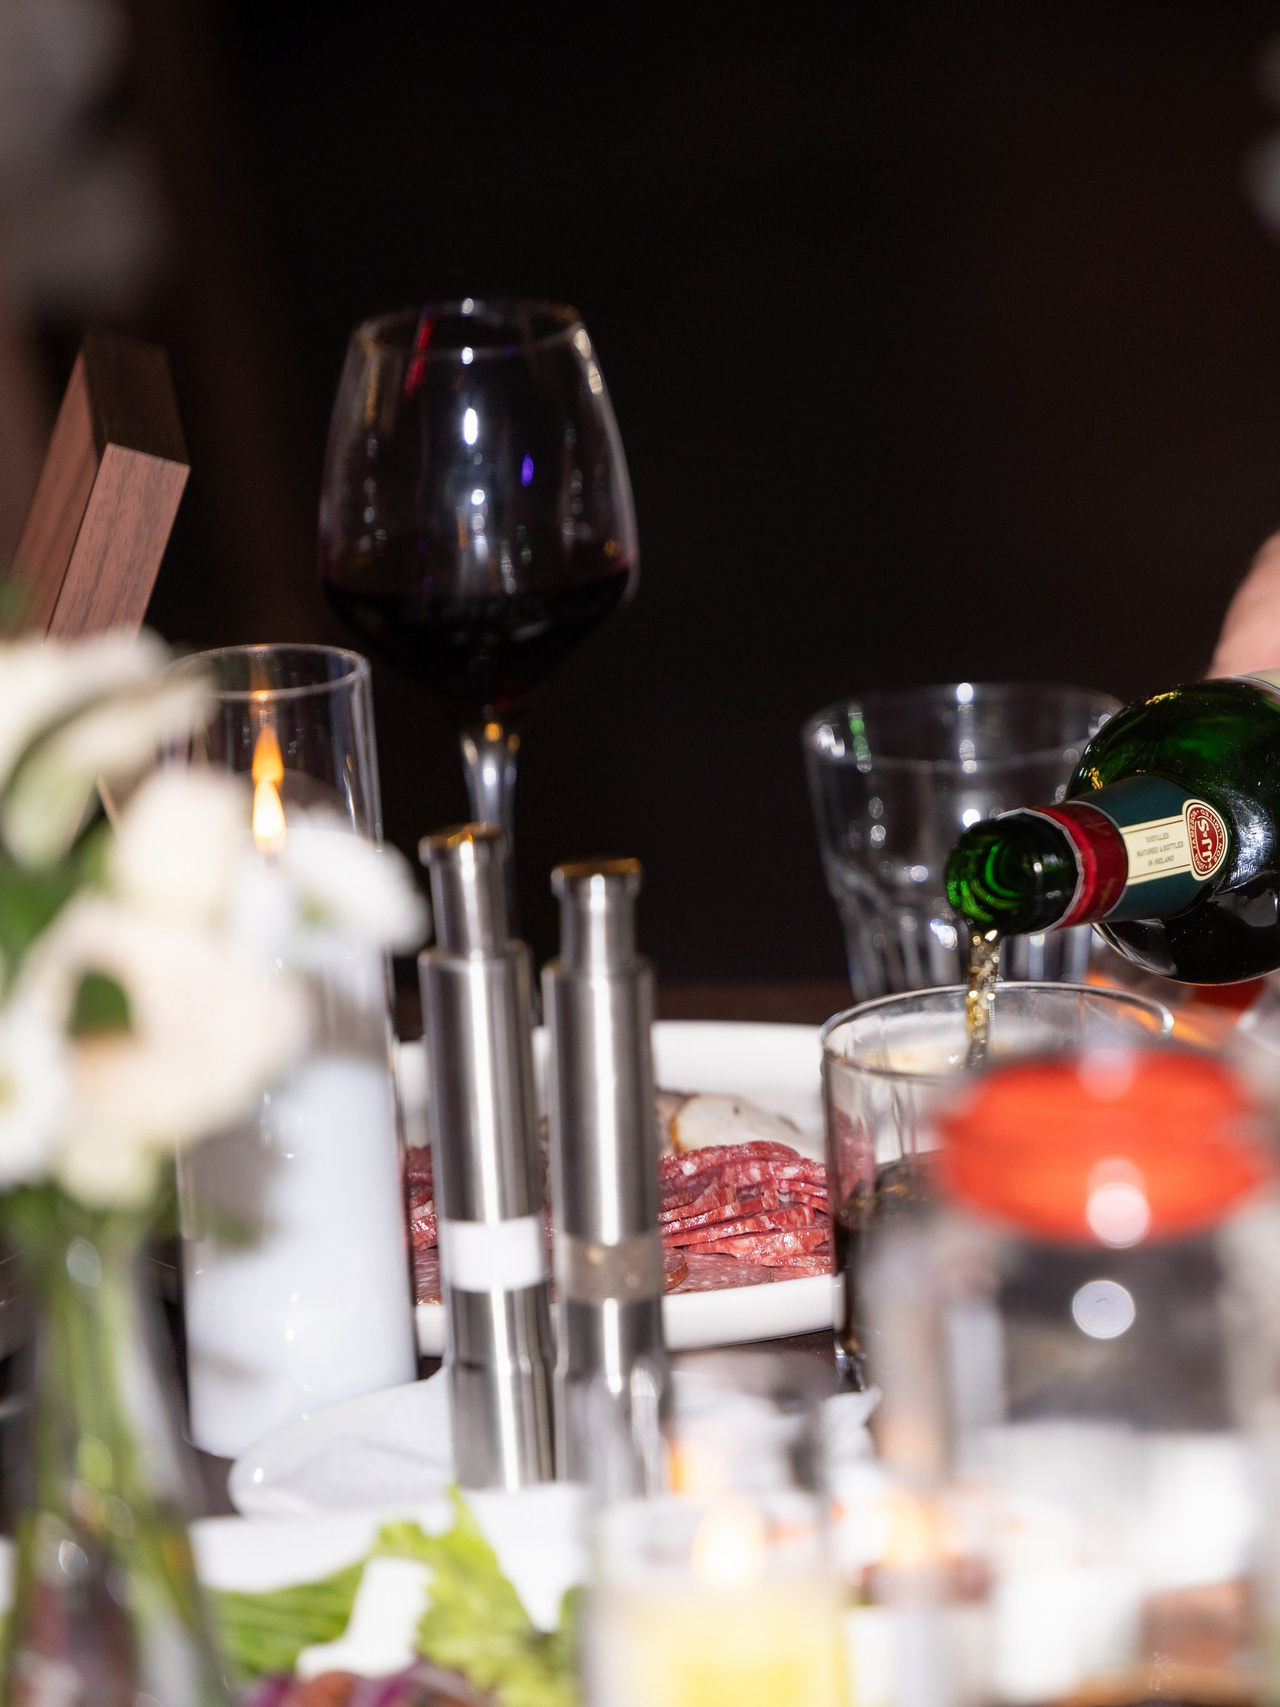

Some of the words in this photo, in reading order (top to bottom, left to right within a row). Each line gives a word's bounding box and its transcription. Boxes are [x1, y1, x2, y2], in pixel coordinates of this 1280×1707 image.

[1190, 809, 1198, 850] JAMESON
[1200, 809, 1222, 839] LIMITED
[1214, 842, 1222, 862] SON
